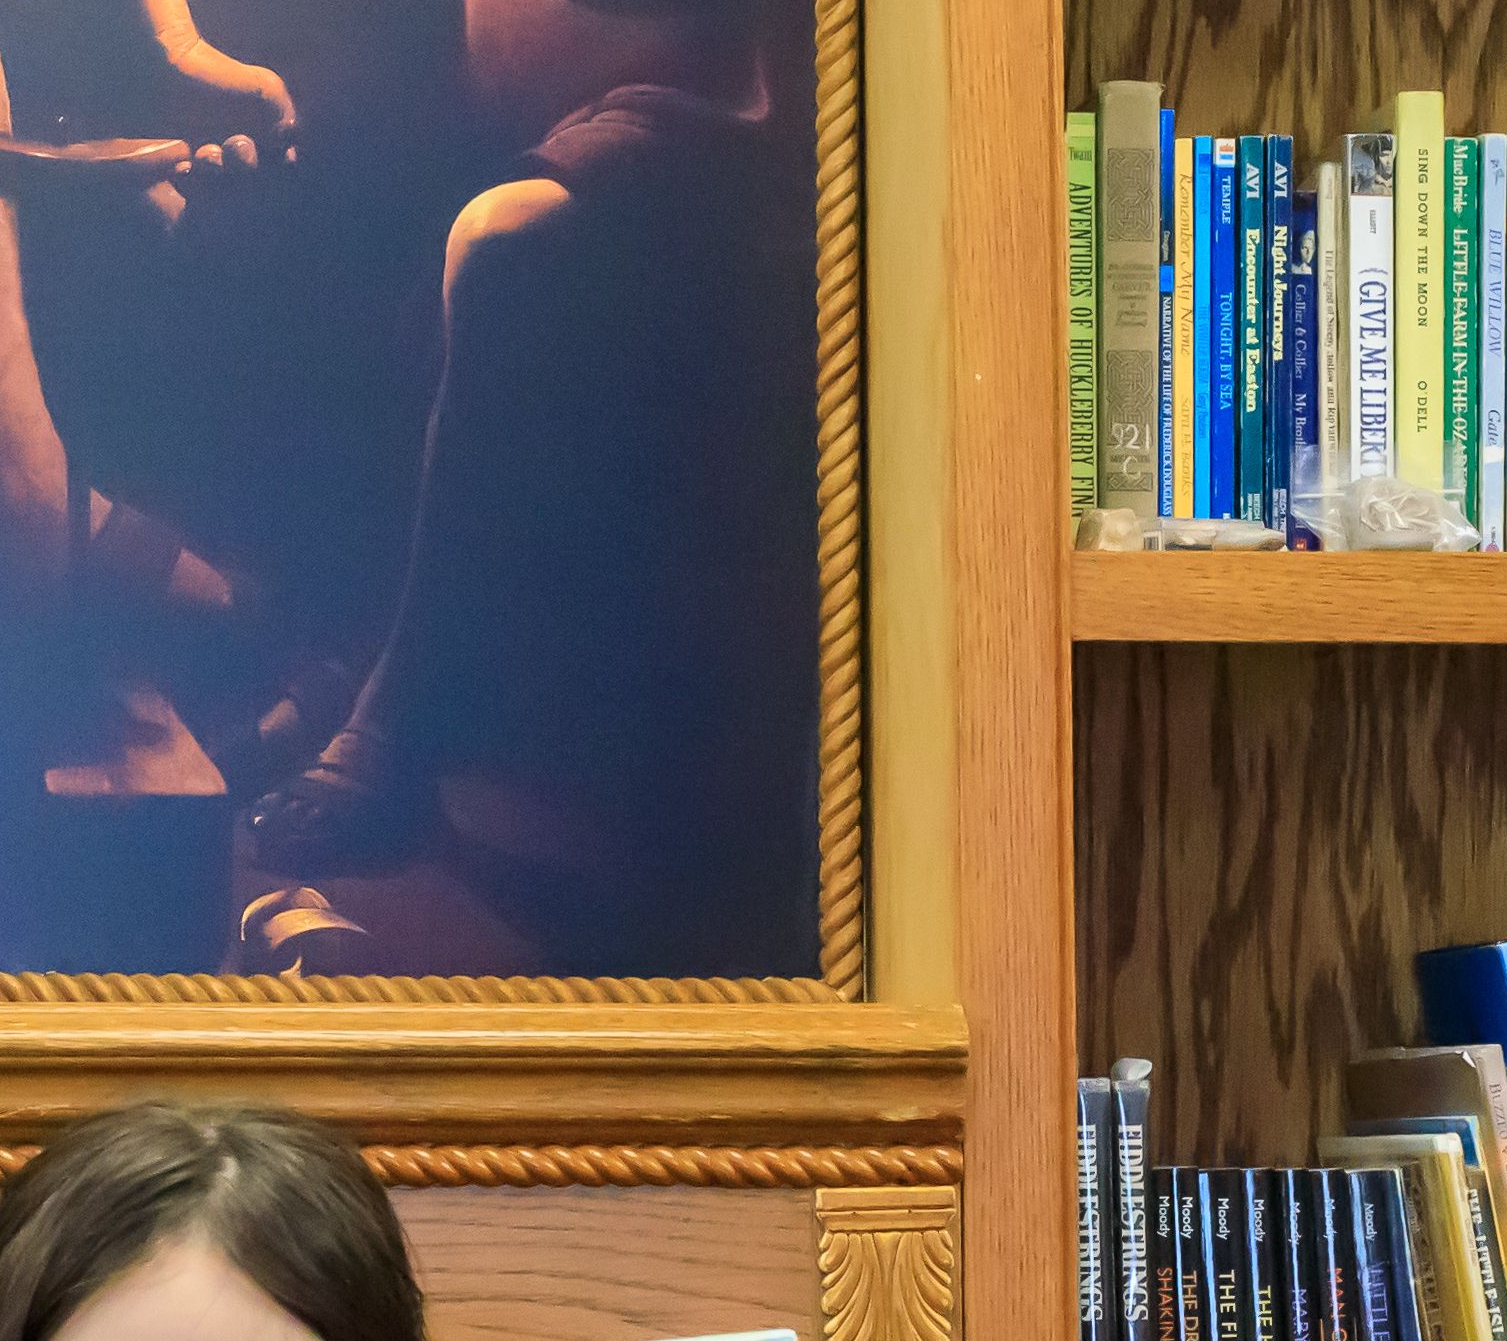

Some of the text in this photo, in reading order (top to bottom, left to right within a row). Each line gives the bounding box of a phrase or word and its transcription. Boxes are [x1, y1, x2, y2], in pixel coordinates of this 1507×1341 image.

[1274, 161, 1287, 198] AVI
[1068, 182, 1092, 298] ADVENTURES
[1417, 148, 1429, 327] SING DOWN THE MOON
[1069, 306, 1092, 328] OF
[1271, 225, 1288, 361] Night Journeys
[1070, 338, 1094, 466] HUCKLEBERRY
[1417, 380, 1429, 433] O'DELL
[1218, 1269, 1235, 1313] THE
